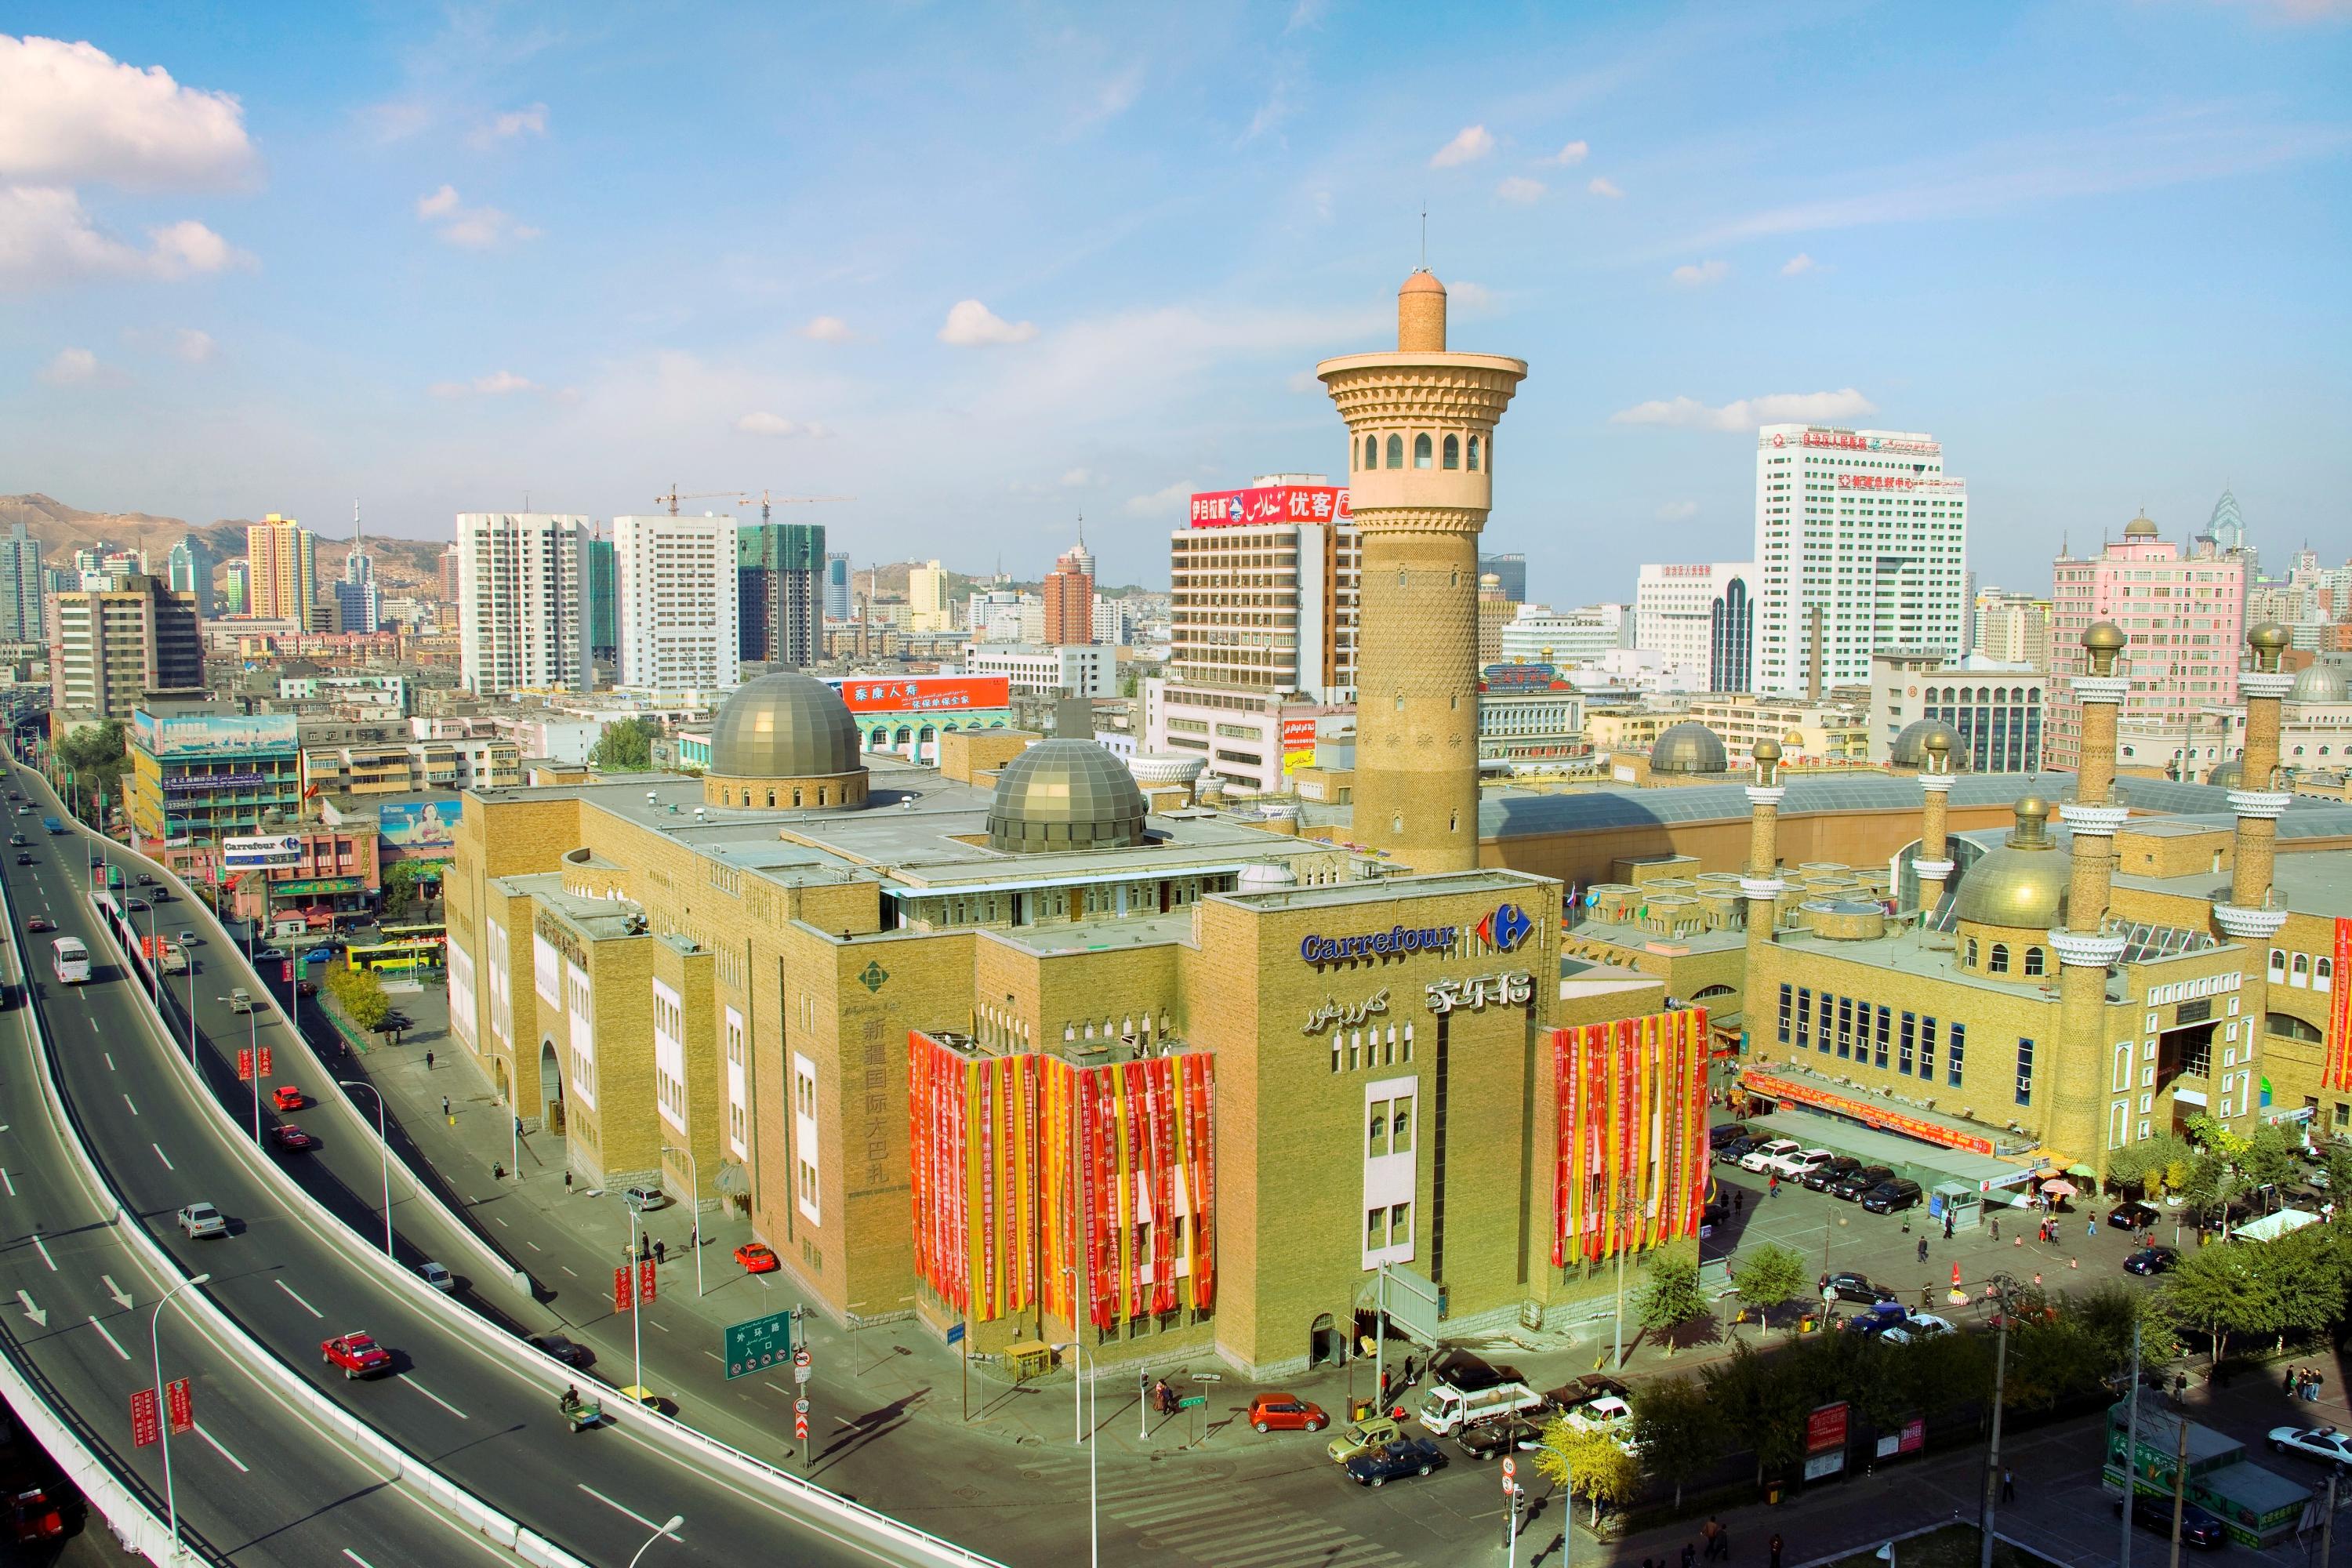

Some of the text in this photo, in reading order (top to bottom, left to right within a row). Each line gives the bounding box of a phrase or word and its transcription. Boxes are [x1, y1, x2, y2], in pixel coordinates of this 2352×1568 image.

[1803, 433, 1867, 449] 自治区人民医院
[1853, 475, 1914, 488] 新疆急救中心
[1289, 492, 1331, 517] 优客
[855, 684, 917, 701] 泰康人寿
[902, 695, 969, 709] 一张保单保全家
[225, 842, 275, 851] Carrefour
[1301, 925, 1455, 963] Carrefour
[1425, 969, 1532, 1014] 家乐福
[737, 1323, 779, 1342] 外环路
[746, 1341, 772, 1356] 入口
[1504, 1461, 1512, 1472] 40
